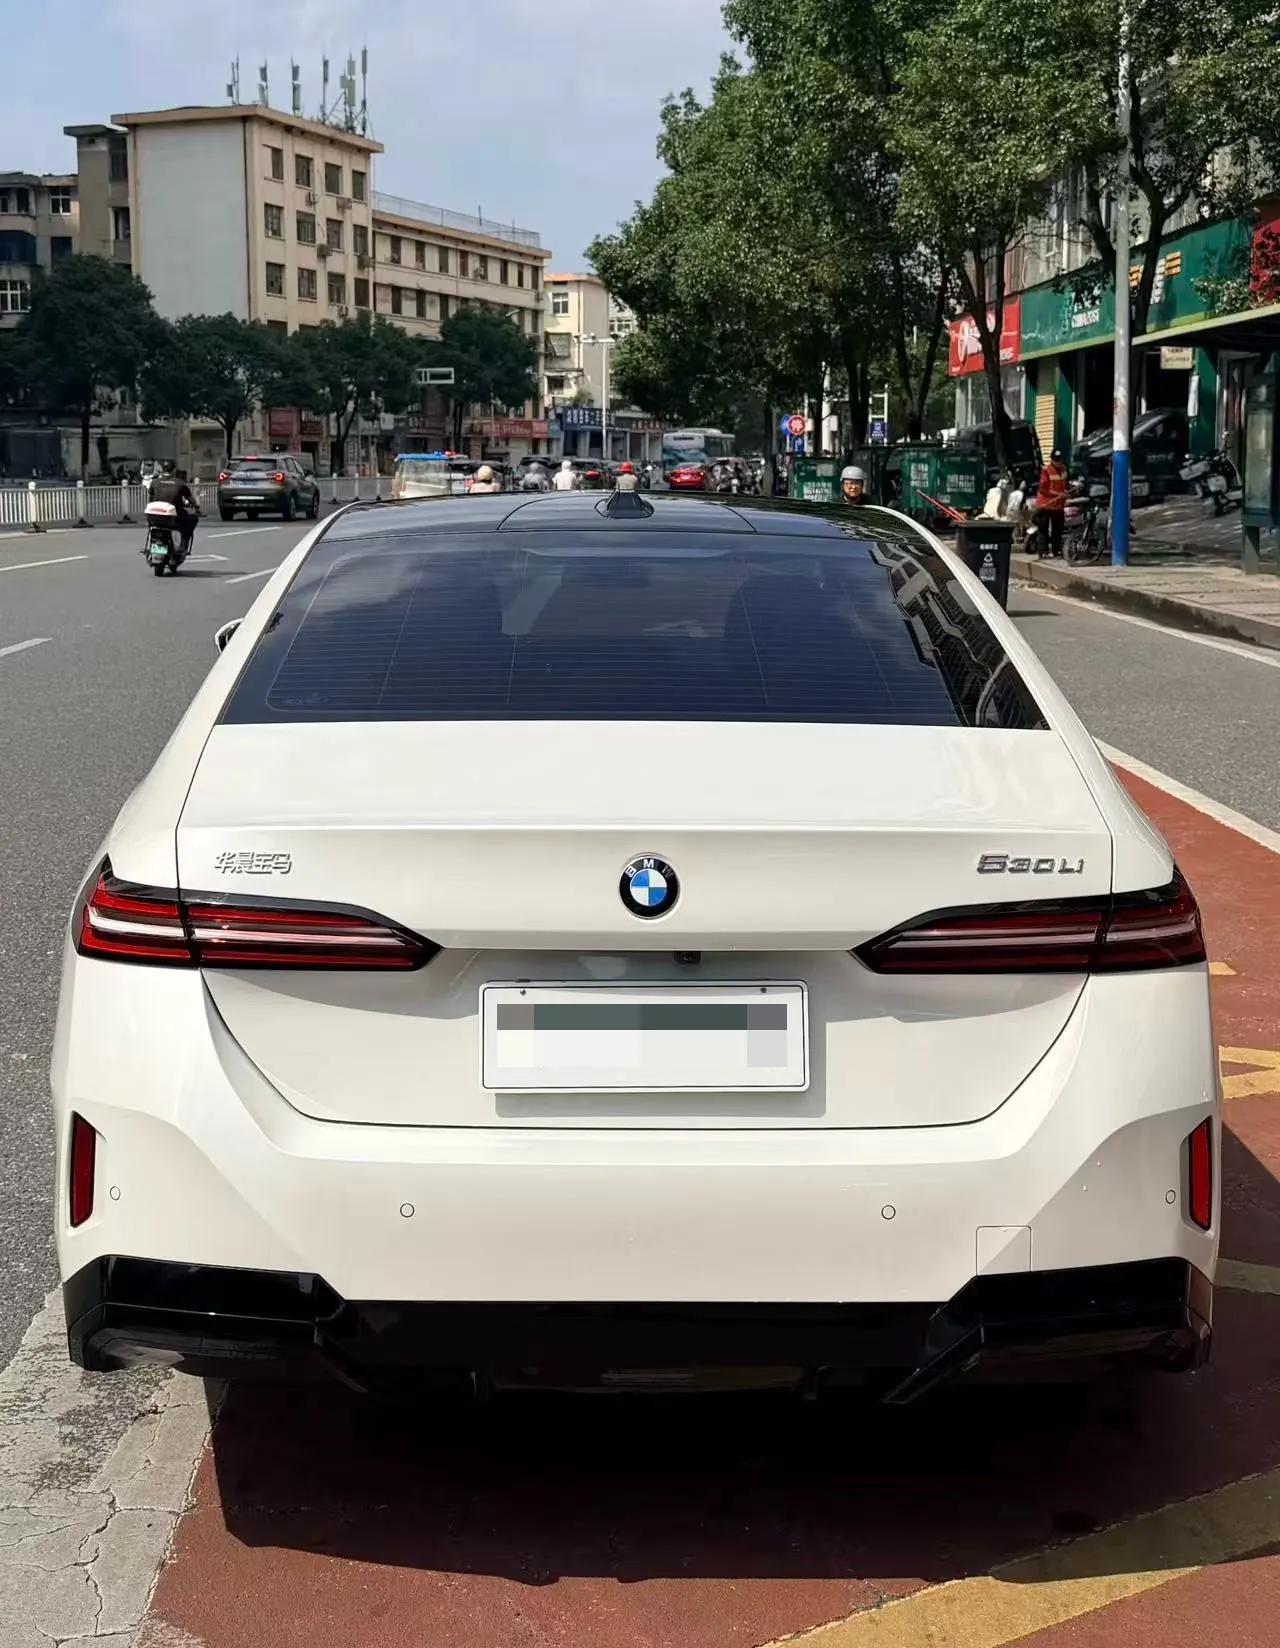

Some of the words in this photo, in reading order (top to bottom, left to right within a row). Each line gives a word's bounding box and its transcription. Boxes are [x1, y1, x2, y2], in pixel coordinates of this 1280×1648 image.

[214, 852, 292, 874] 华晨宝马
[625, 858, 674, 879] BMW
